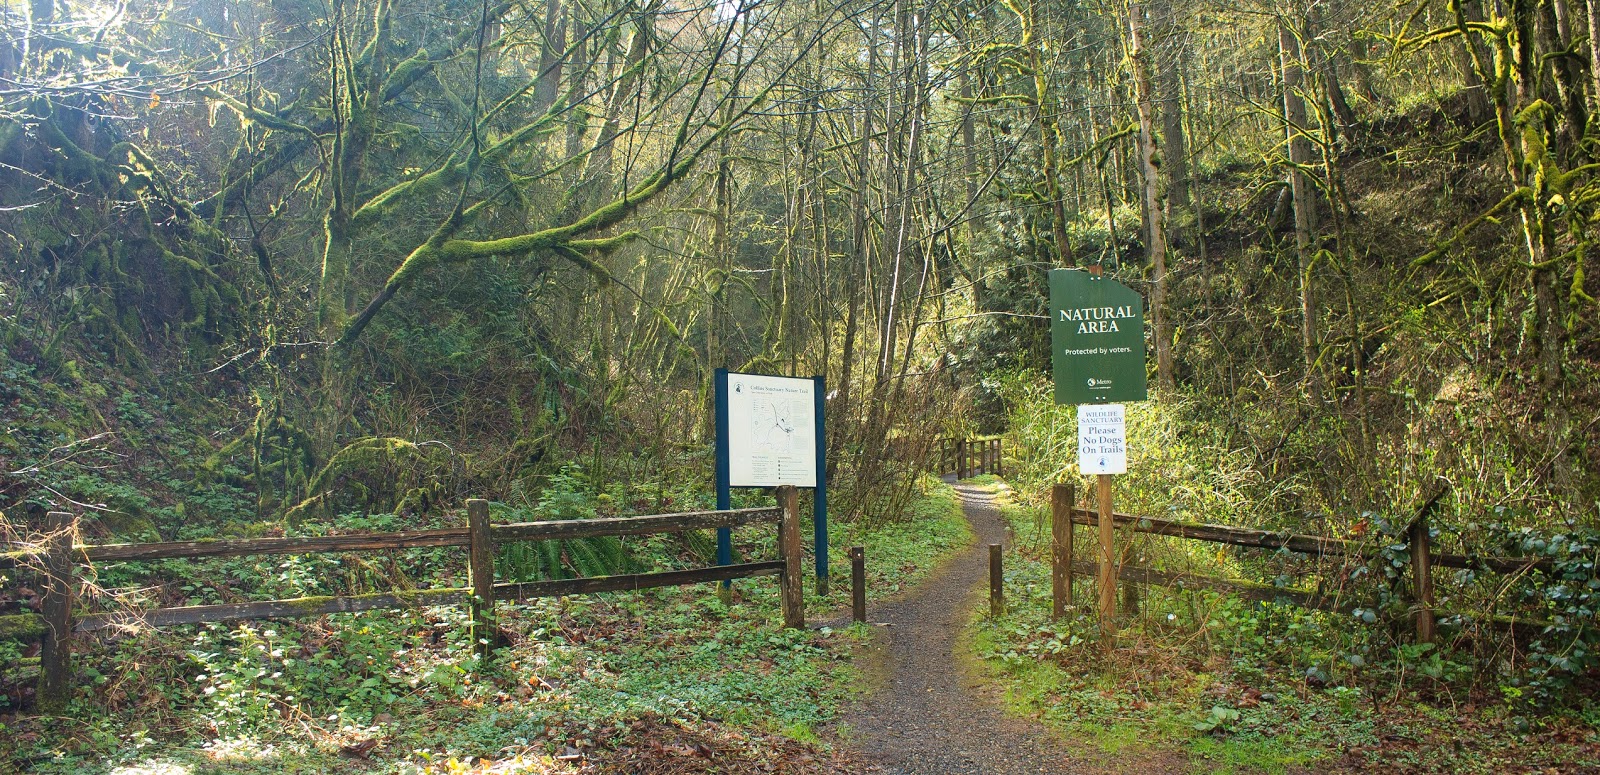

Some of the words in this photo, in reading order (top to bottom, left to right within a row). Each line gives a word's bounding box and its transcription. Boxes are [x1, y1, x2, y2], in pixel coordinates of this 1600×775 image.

[1060, 306, 1136, 322] NATURAL
[1077, 320, 1119, 334] AREA
[1065, 347, 1098, 356] Protected
[1099, 347, 1107, 355] by
[1088, 426, 1116, 434] Please
[1083, 436, 1097, 444] No
[1099, 436, 1122, 446] Dogs
[1082, 446, 1097, 454] On
[1099, 445, 1123, 454] Trails
